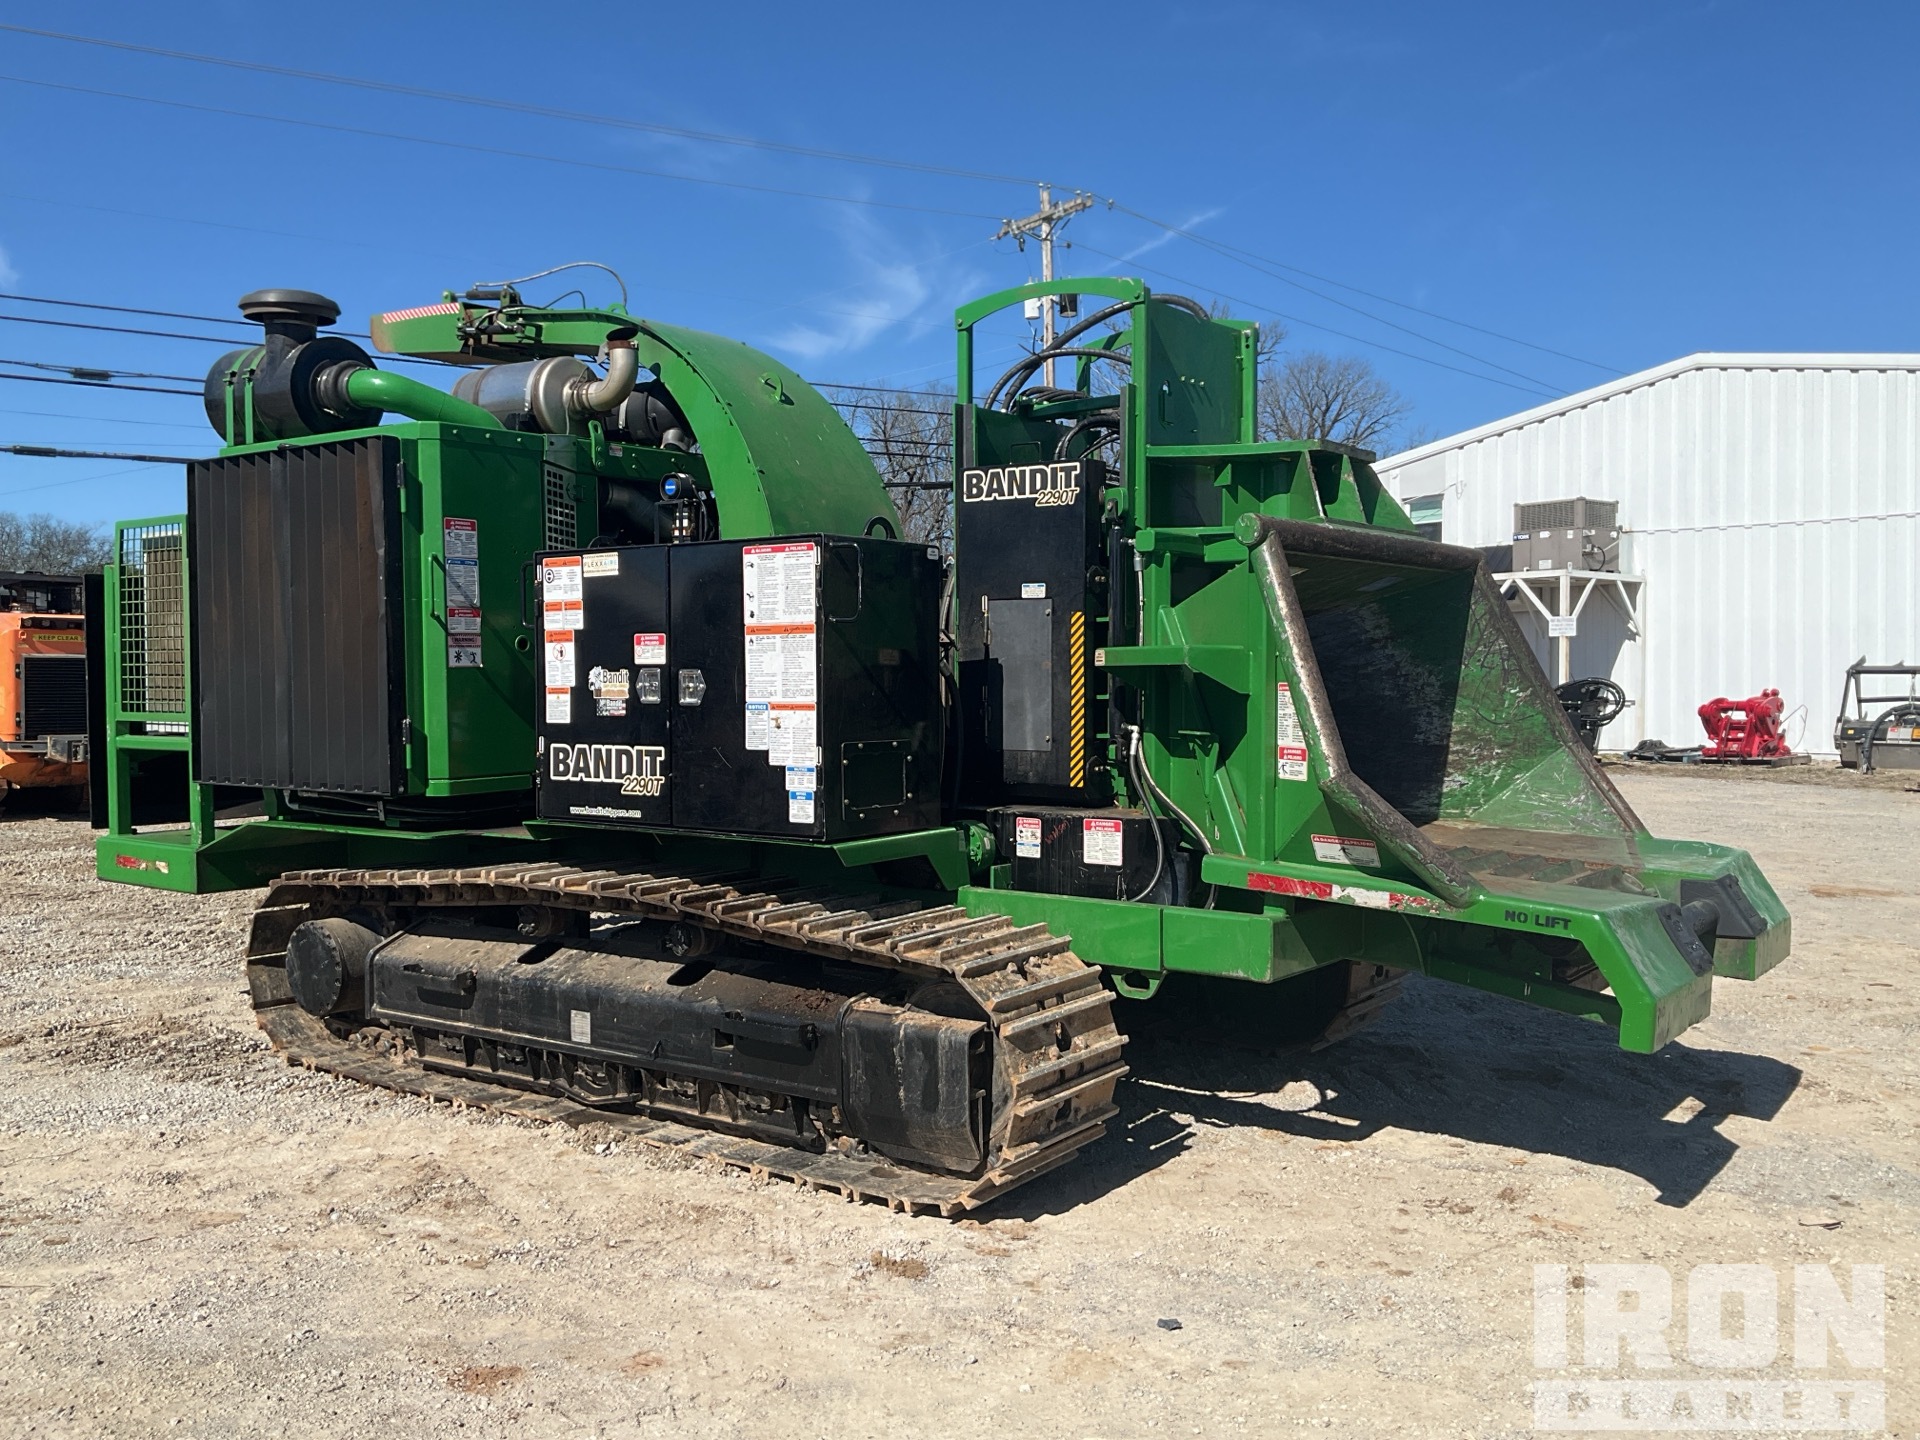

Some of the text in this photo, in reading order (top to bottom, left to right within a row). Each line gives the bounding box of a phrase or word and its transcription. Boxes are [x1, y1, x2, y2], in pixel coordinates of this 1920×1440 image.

[963, 462, 1080, 502] BANDIT
[1035, 488, 1079, 507] 2290T
[602, 670, 629, 684] Bandit
[550, 744, 664, 783] BANDIT
[621, 777, 664, 796] 2290T
[569, 806, 642, 819] www.banditchippers.com
[1504, 910, 1572, 930] NO LIFT
